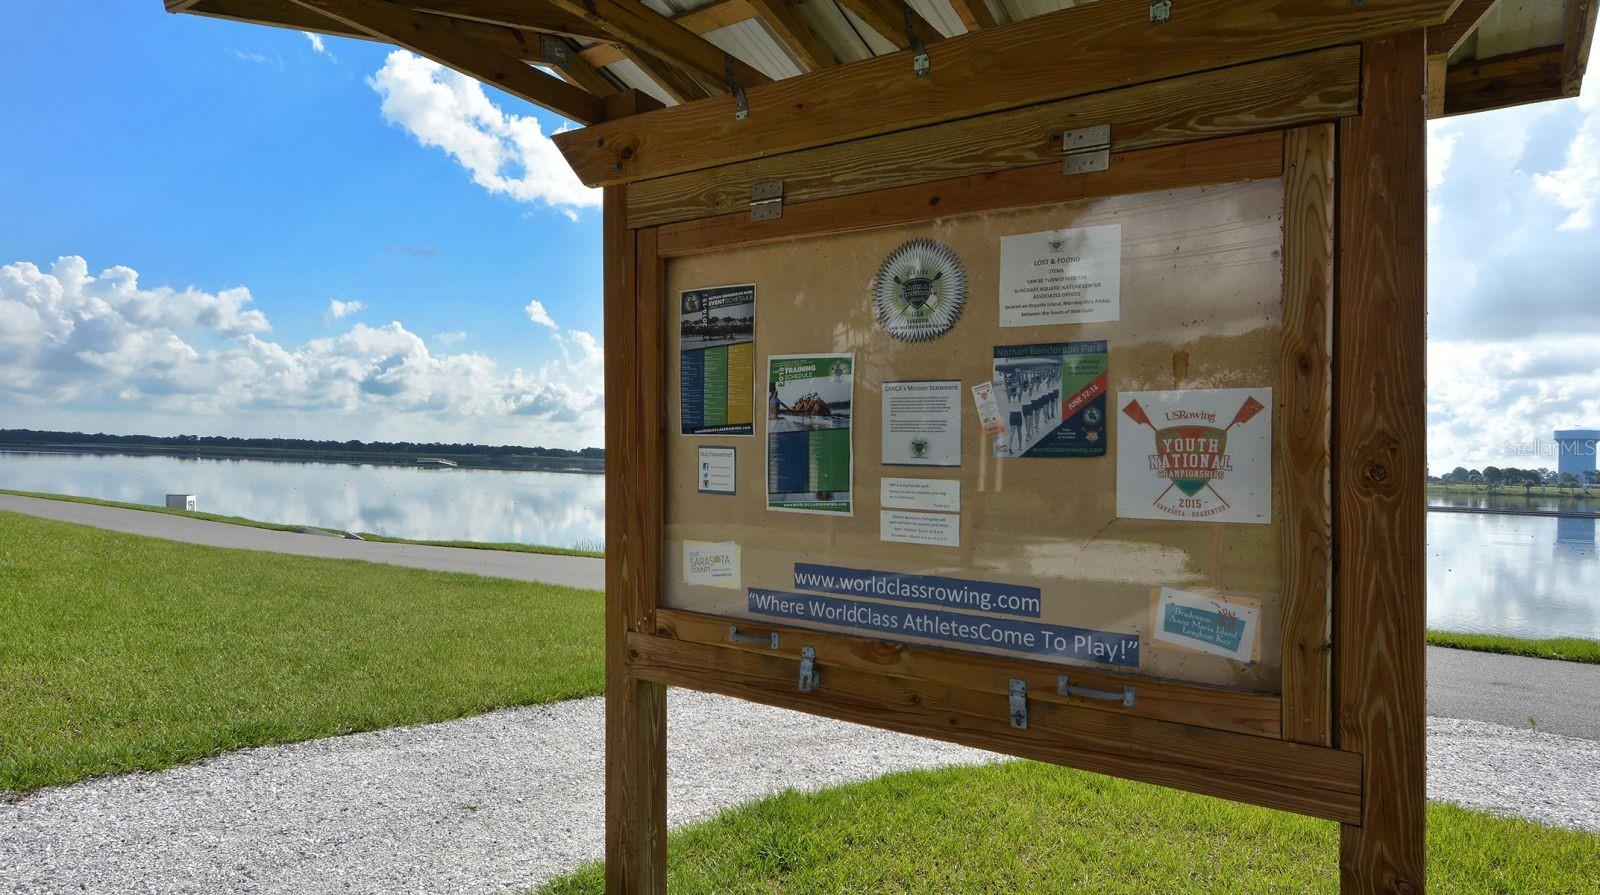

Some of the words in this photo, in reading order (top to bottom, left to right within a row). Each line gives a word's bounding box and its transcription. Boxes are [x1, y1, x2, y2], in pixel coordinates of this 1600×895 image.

[998, 347, 1028, 356] Nathan
[1030, 346, 1078, 355] Benderson
[1081, 344, 1102, 353] Park
[785, 365, 816, 373] TRAINING
[1068, 396, 1082, 410] JUNE
[1165, 410, 1216, 423] USRowing
[1163, 438, 1219, 453] YOUTH
[1148, 453, 1232, 472] NATIONAL
[1158, 469, 1224, 480] CHAMPIONSHIPS
[1156, 503, 1185, 517] SARASOTA
[1192, 506, 1226, 517] BRADENTON
[1178, 499, 1202, 508] 2015
[794, 572, 1040, 612] www.worldclassrowing.com
[809, 600, 898, 628] WorldClass
[903, 613, 1035, 647] AthletesCome
[1041, 630, 1066, 650] To
[1169, 615, 1189, 625] Anna
[1192, 620, 1214, 632] Maria
[1216, 627, 1237, 638] Island
